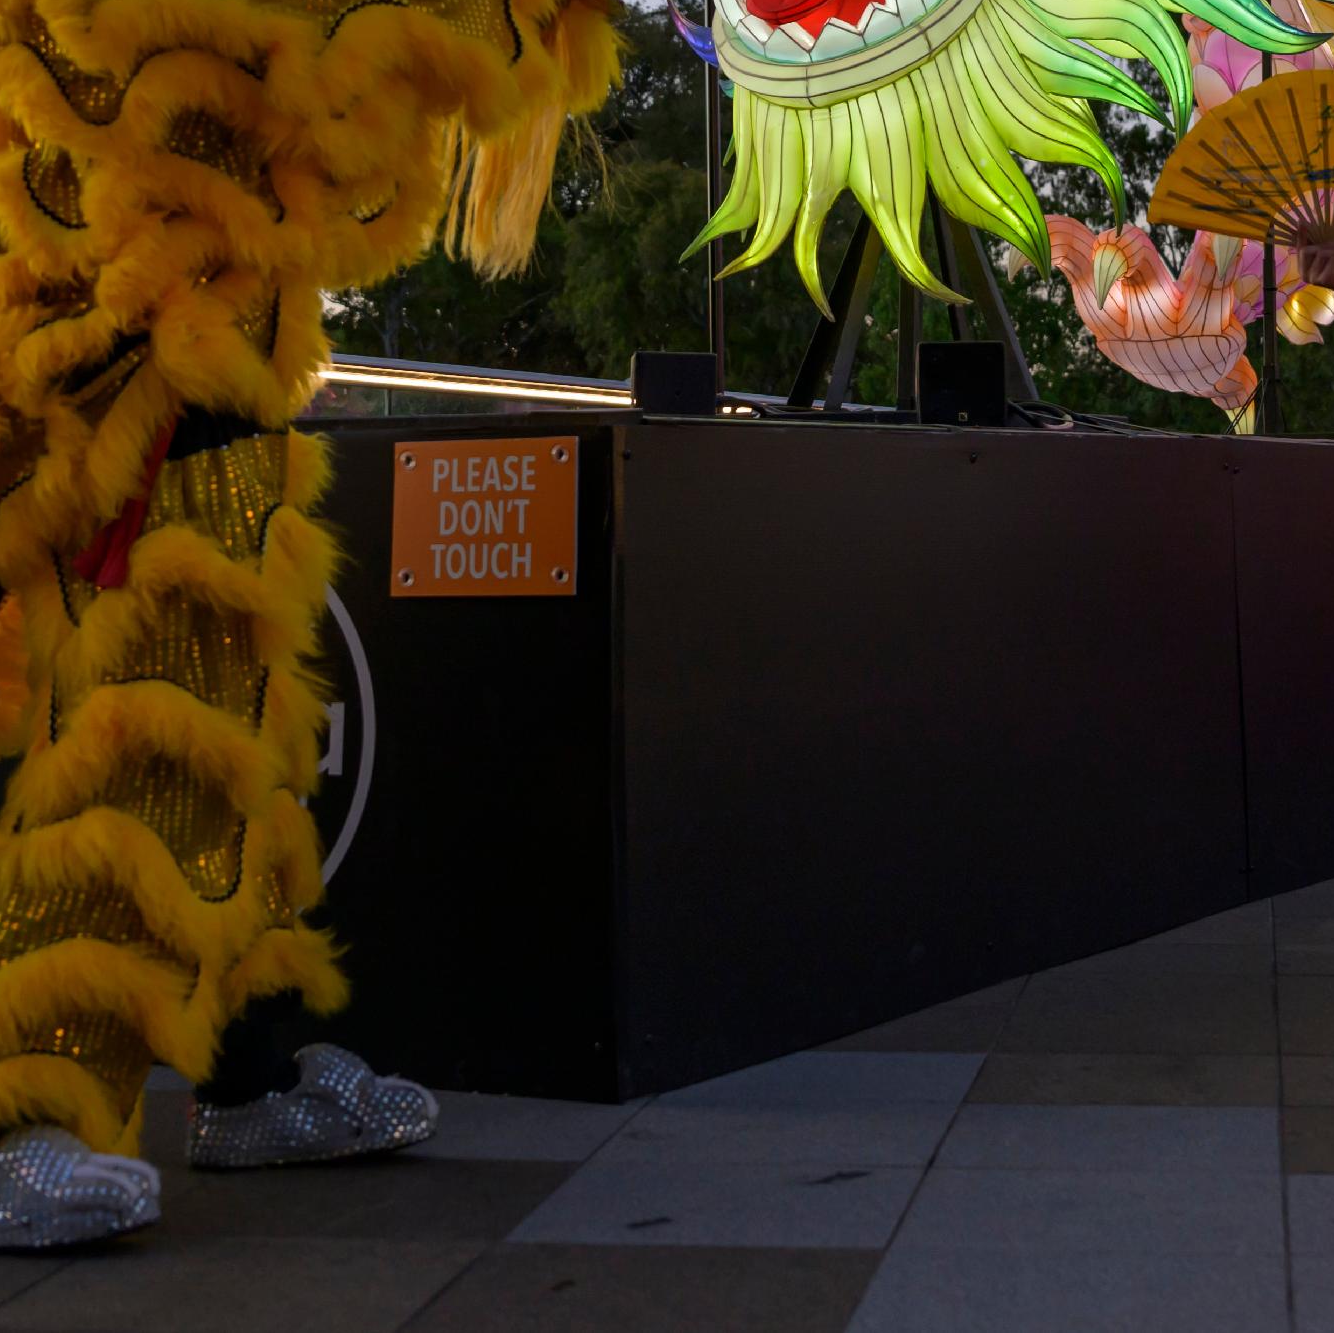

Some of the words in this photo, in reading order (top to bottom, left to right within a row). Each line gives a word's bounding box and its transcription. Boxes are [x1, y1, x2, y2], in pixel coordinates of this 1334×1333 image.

[432, 455, 536, 493] PLEASE
[439, 499, 529, 536] DON'T
[430, 543, 532, 579] TOUCH
